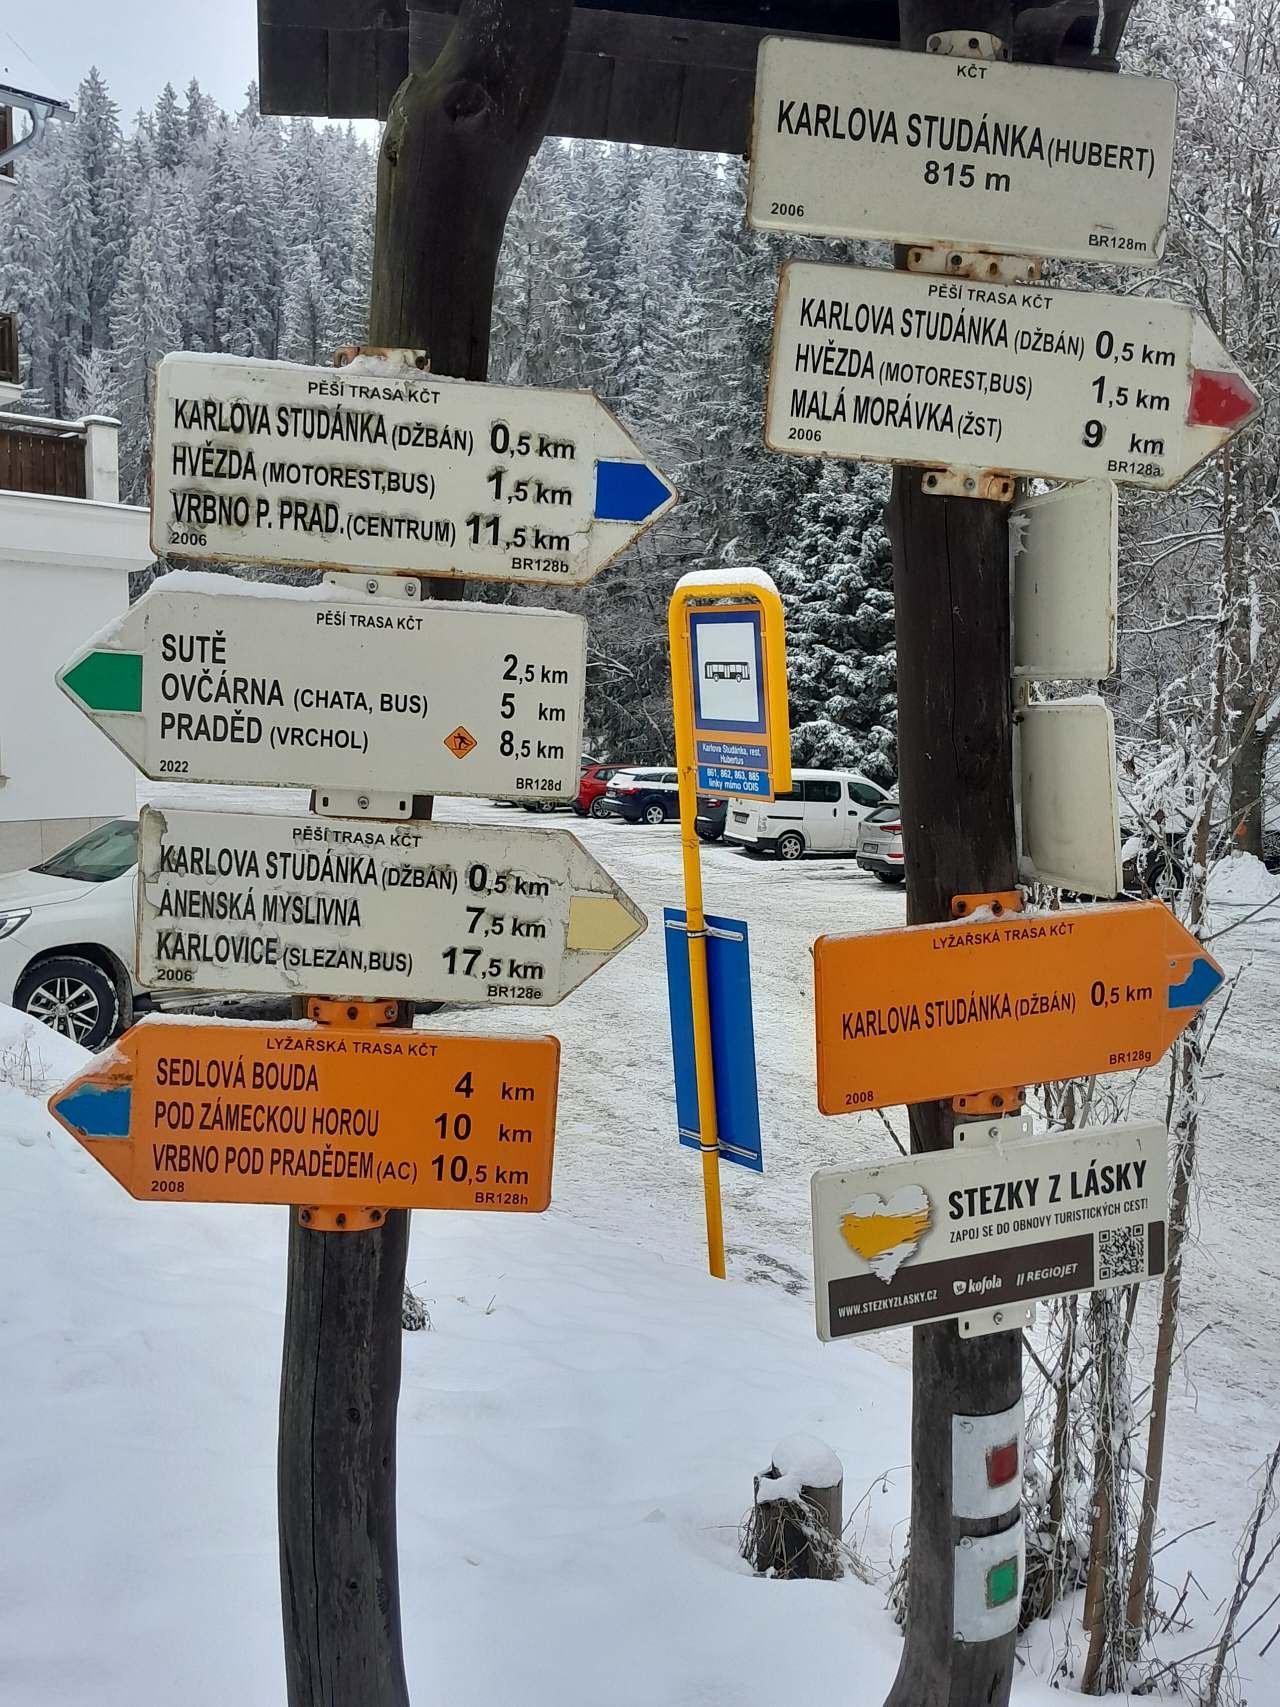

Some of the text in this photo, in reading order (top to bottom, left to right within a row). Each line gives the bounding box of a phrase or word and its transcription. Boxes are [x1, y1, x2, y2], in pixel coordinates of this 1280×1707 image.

[957, 64, 986, 79] KČT
[777, 100, 1156, 179] KARLOVA STUDÁNKA (HUBERT)
[924, 160, 1011, 192] 815 m
[771, 202, 804, 218] 2006
[1088, 234, 1147, 252] BR128m
[928, 284, 1052, 310] PĚŠÍ TRASA KČT
[800, 298, 1175, 366] KARLOVA STUDÁNKA (DŽBÁN) 0,5 km
[795, 339, 874, 380] HVĚZDA
[1091, 376, 1129, 408] 1,5
[1136, 389, 1170, 411] km
[308, 380, 440, 404] PĚŠÍ TRASA KČT
[174, 399, 575, 460] KARLOVA STUDÁNKA (DŽBÁN) 0,5 km
[790, 387, 1164, 455] MALÁ MORÁVKA (ŽST) 9 km
[789, 427, 821, 442] 2006
[173, 441, 256, 481] HVĚZDA
[487, 467, 527, 503] 1,5
[535, 484, 572, 505] km
[1108, 460, 1160, 476] BR128a
[173, 493, 248, 526] VRBNO
[256, 498, 272, 529] P.
[466, 515, 526, 548] 11,5
[533, 531, 570, 552] km
[172, 532, 207, 547] 2006
[512, 557, 569, 574] BR128b
[316, 611, 423, 632] PĚŠÍ TRASA KČT
[162, 630, 568, 684] SUTĚ 2,5 km
[161, 668, 565, 721] OVČÁRNA (CHATA, BUS) 5 km
[161, 710, 564, 760] PRADĚD (VRCHOL) 8,5 km
[703, 743, 721, 753] Karlova
[160, 760, 188, 773] 2022
[720, 755, 744, 765] Hubertus
[516, 778, 561, 792] BR128d
[293, 828, 422, 848] PĚŠÍ TRASA KČT
[160, 845, 549, 896] KARLOVA STUDÁNKA (DŽBÁN) 0,5 km
[159, 886, 546, 938] ANENSKÁ MYSLIVNA 7,5 km
[933, 923, 1074, 949] LYŽAŘSKÁ TRASA KČT
[157, 932, 277, 965] KARLOVICE
[442, 947, 501, 981] 17,5
[508, 958, 543, 979] km
[158, 969, 192, 982] 2006
[488, 985, 542, 1000] BR128e
[842, 981, 1153, 1040] KARLOVA STUDÁNKA (DŽBÁN) 0,5 km
[267, 1037, 438, 1057] LYŽAŘSKÁ TRASA KČT
[1109, 1049, 1151, 1065] BR128g
[156, 1056, 534, 1102] SEDLOVÁ BOUDA 4 km
[846, 1091, 873, 1104] 2008
[155, 1099, 532, 1143] POD ZÁMECKOU HOROU 10 km
[153, 1143, 218, 1173] VRBNO
[225, 1147, 264, 1175] POD
[270, 1145, 372, 1179] PRADĚDEM
[432, 1156, 487, 1185] 10,5
[496, 1165, 529, 1184] km
[151, 1181, 184, 1193] 2008
[475, 1191, 528, 1205] BR128h
[948, 1160, 1147, 1219] STEZKY Z LÁSKY
[950, 1198, 1148, 1243] ZAPOJ SE DO OBNOVY TURISTICKÝCH CEST!
[968, 1274, 1002, 1295] kofola
[838, 1289, 938, 1318] WWW.STEZKYZLASKY.CZ
